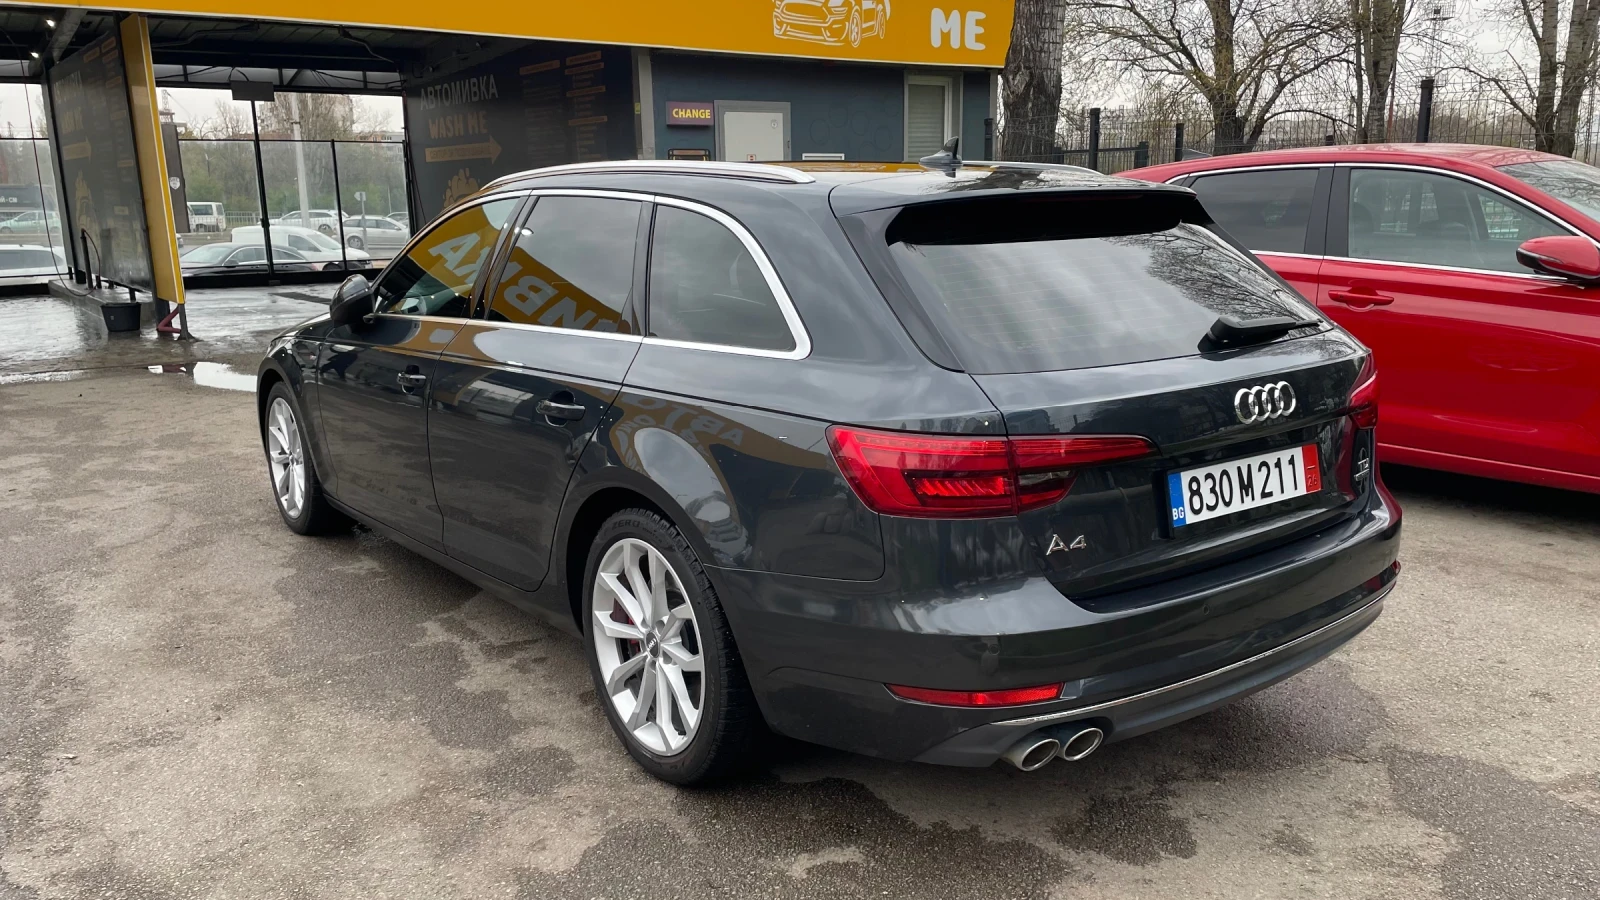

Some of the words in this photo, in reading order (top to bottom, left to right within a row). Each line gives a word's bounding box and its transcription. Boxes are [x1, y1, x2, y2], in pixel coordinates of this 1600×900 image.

[930, 7, 987, 51] ME
[420, 74, 499, 111] АВТОМИВКА
[428, 113, 464, 140] WASH
[468, 111, 488, 135] ME
[672, 107, 712, 119] CHANGE
[1172, 507, 1185, 521] BG
[1046, 533, 1087, 556] A4
